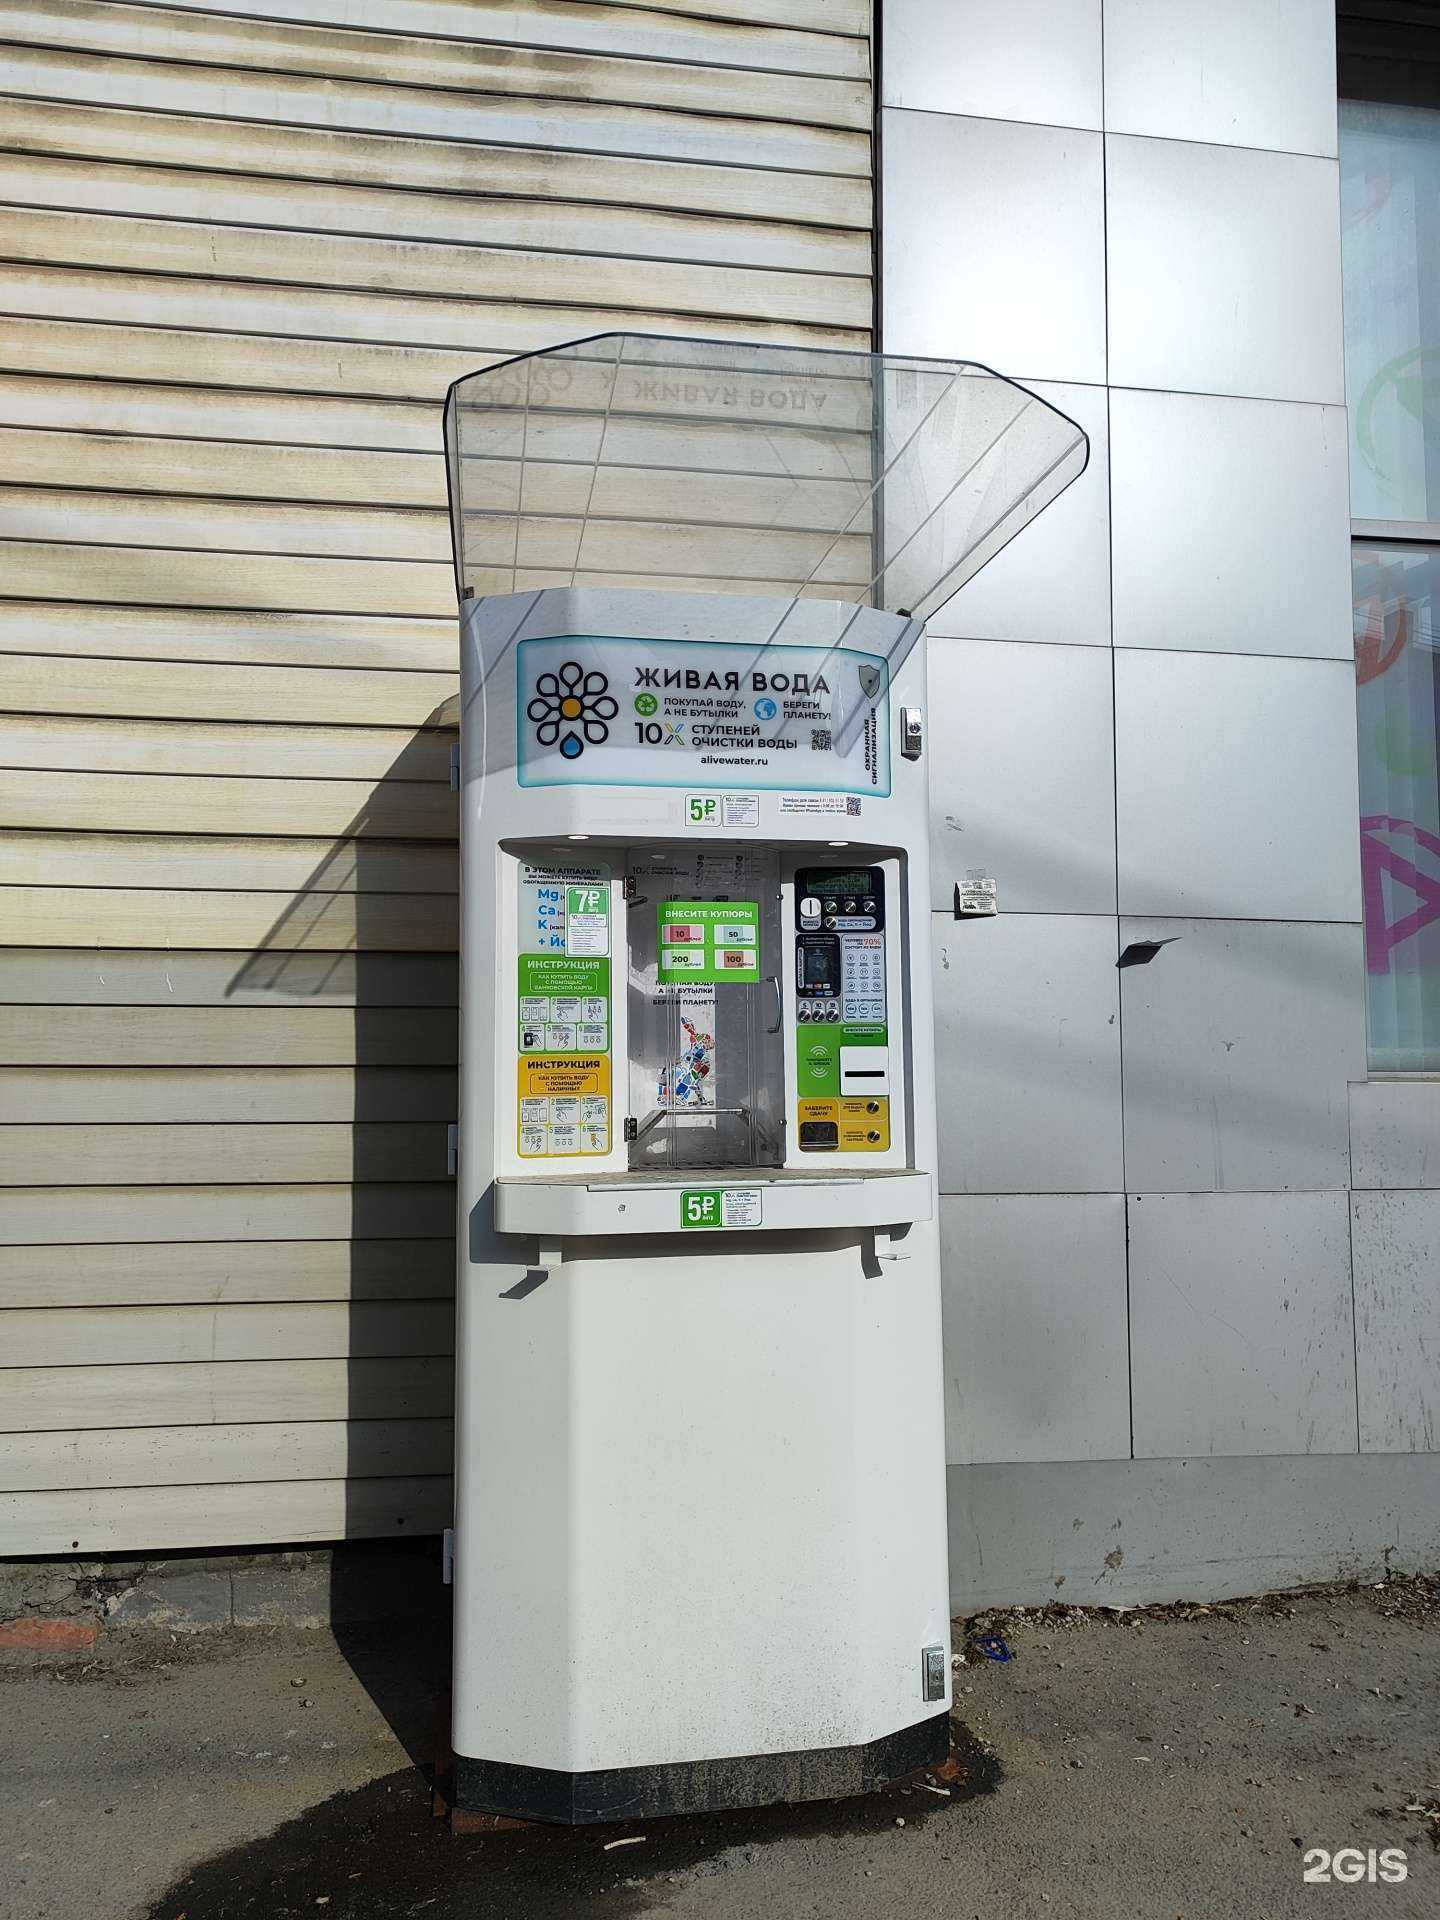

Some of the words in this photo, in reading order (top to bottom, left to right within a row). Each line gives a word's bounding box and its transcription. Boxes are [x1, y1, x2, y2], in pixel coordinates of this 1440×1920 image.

[634, 667, 740, 691] ЖИВАЯ
[752, 672, 831, 696] ВОДА
[664, 697, 714, 707] ПОКУПАЙ
[716, 700, 747, 709] ВОДУ,
[783, 701, 820, 710] БЕРЕГИ
[664, 708, 672, 716] А
[674, 708, 688, 717] НЕ
[690, 709, 738, 718] БУТЫЛКИ
[783, 711, 832, 721] ПЛАНЕТУ!
[691, 724, 761, 736] СТУПЕНЕЙ
[691, 736, 754, 748] ОЧИСТКИ
[758, 738, 798, 750] ВОДЫ
[700, 755, 768, 766] alivewater.ru
[532, 866, 556, 874] ЭТОМ
[537, 889, 559, 901] Mg
[575, 890, 601, 913] 7₽
[538, 905, 556, 915] Ca
[665, 910, 708, 918] ВНЕСИТЕ
[710, 910, 753, 918] КУПЮРЫ
[538, 920, 548, 929] K
[675, 930, 685, 938] 10
[550, 934, 565, 947] Йо
[672, 955, 689, 963] 200
[726, 955, 742, 963] 100
[527, 960, 600, 970] ИНСТРУКЦИЯ
[527, 1060, 600, 1069] ИНСТРУКЦИЯ
[687, 1196, 715, 1221] 5₽
